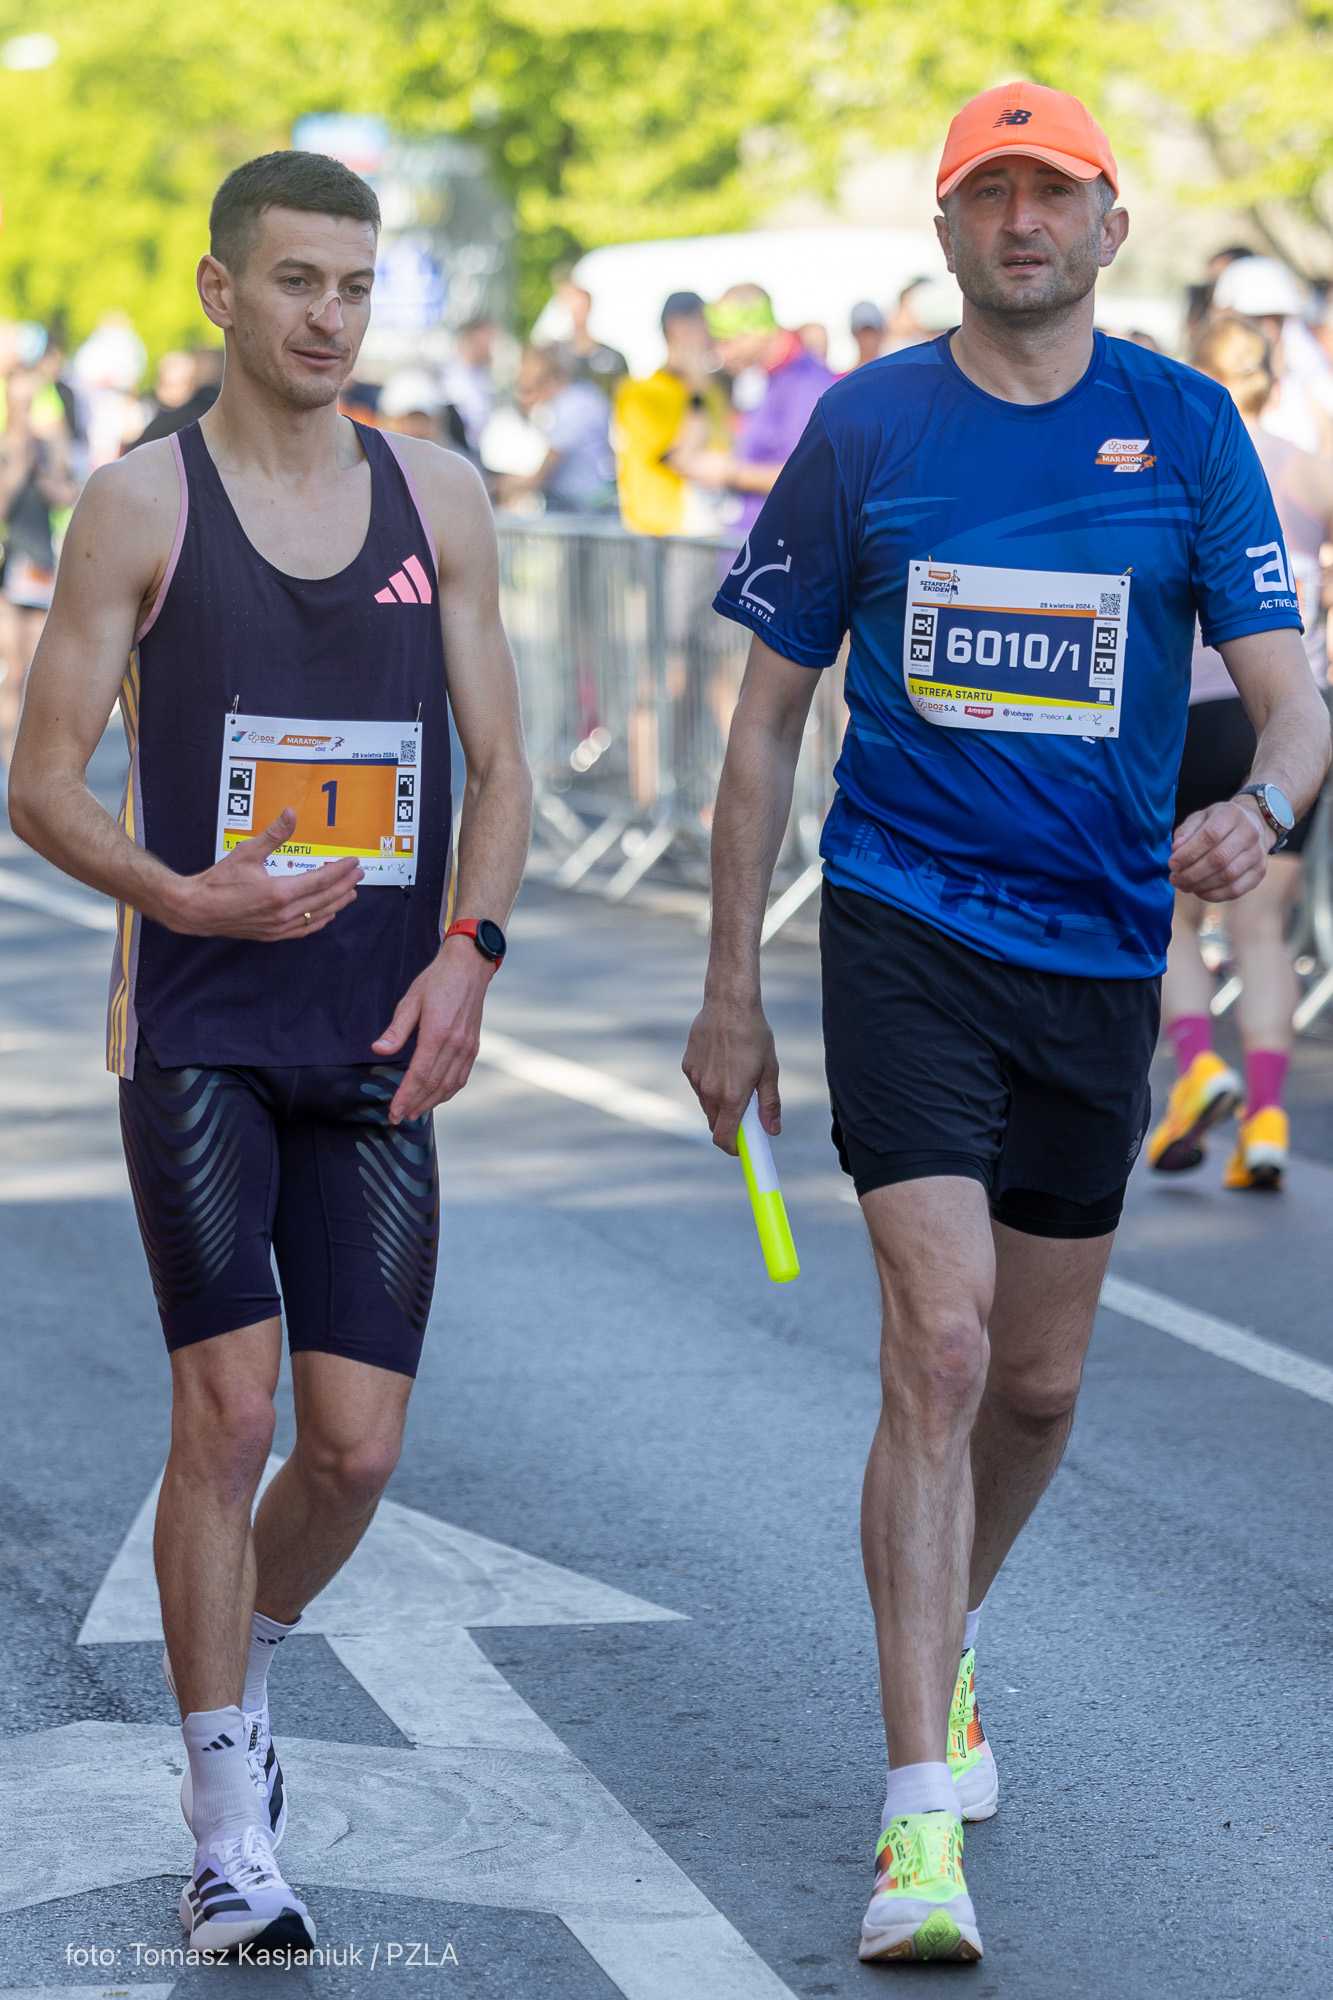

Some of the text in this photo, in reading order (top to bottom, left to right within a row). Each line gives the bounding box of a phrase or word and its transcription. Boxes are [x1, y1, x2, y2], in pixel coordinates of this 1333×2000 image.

[1102, 455, 1143, 463] MARATON
[919, 580, 950, 588] SZTAFETA
[738, 598, 771, 623] KREUJE
[946, 627, 1081, 673] 6010/1
[911, 685, 993, 702] 1. STREFA STARTU
[927, 702, 944, 711] DOZ
[944, 705, 958, 713] S.A.
[1010, 710, 1034, 718] Voltaren
[1040, 713, 1065, 721] Pelion
[286, 737, 321, 745] MARATON
[321, 780, 338, 828] 1
[226, 840, 312, 855] 1. STARTU
[264, 859, 278, 868] S.A.
